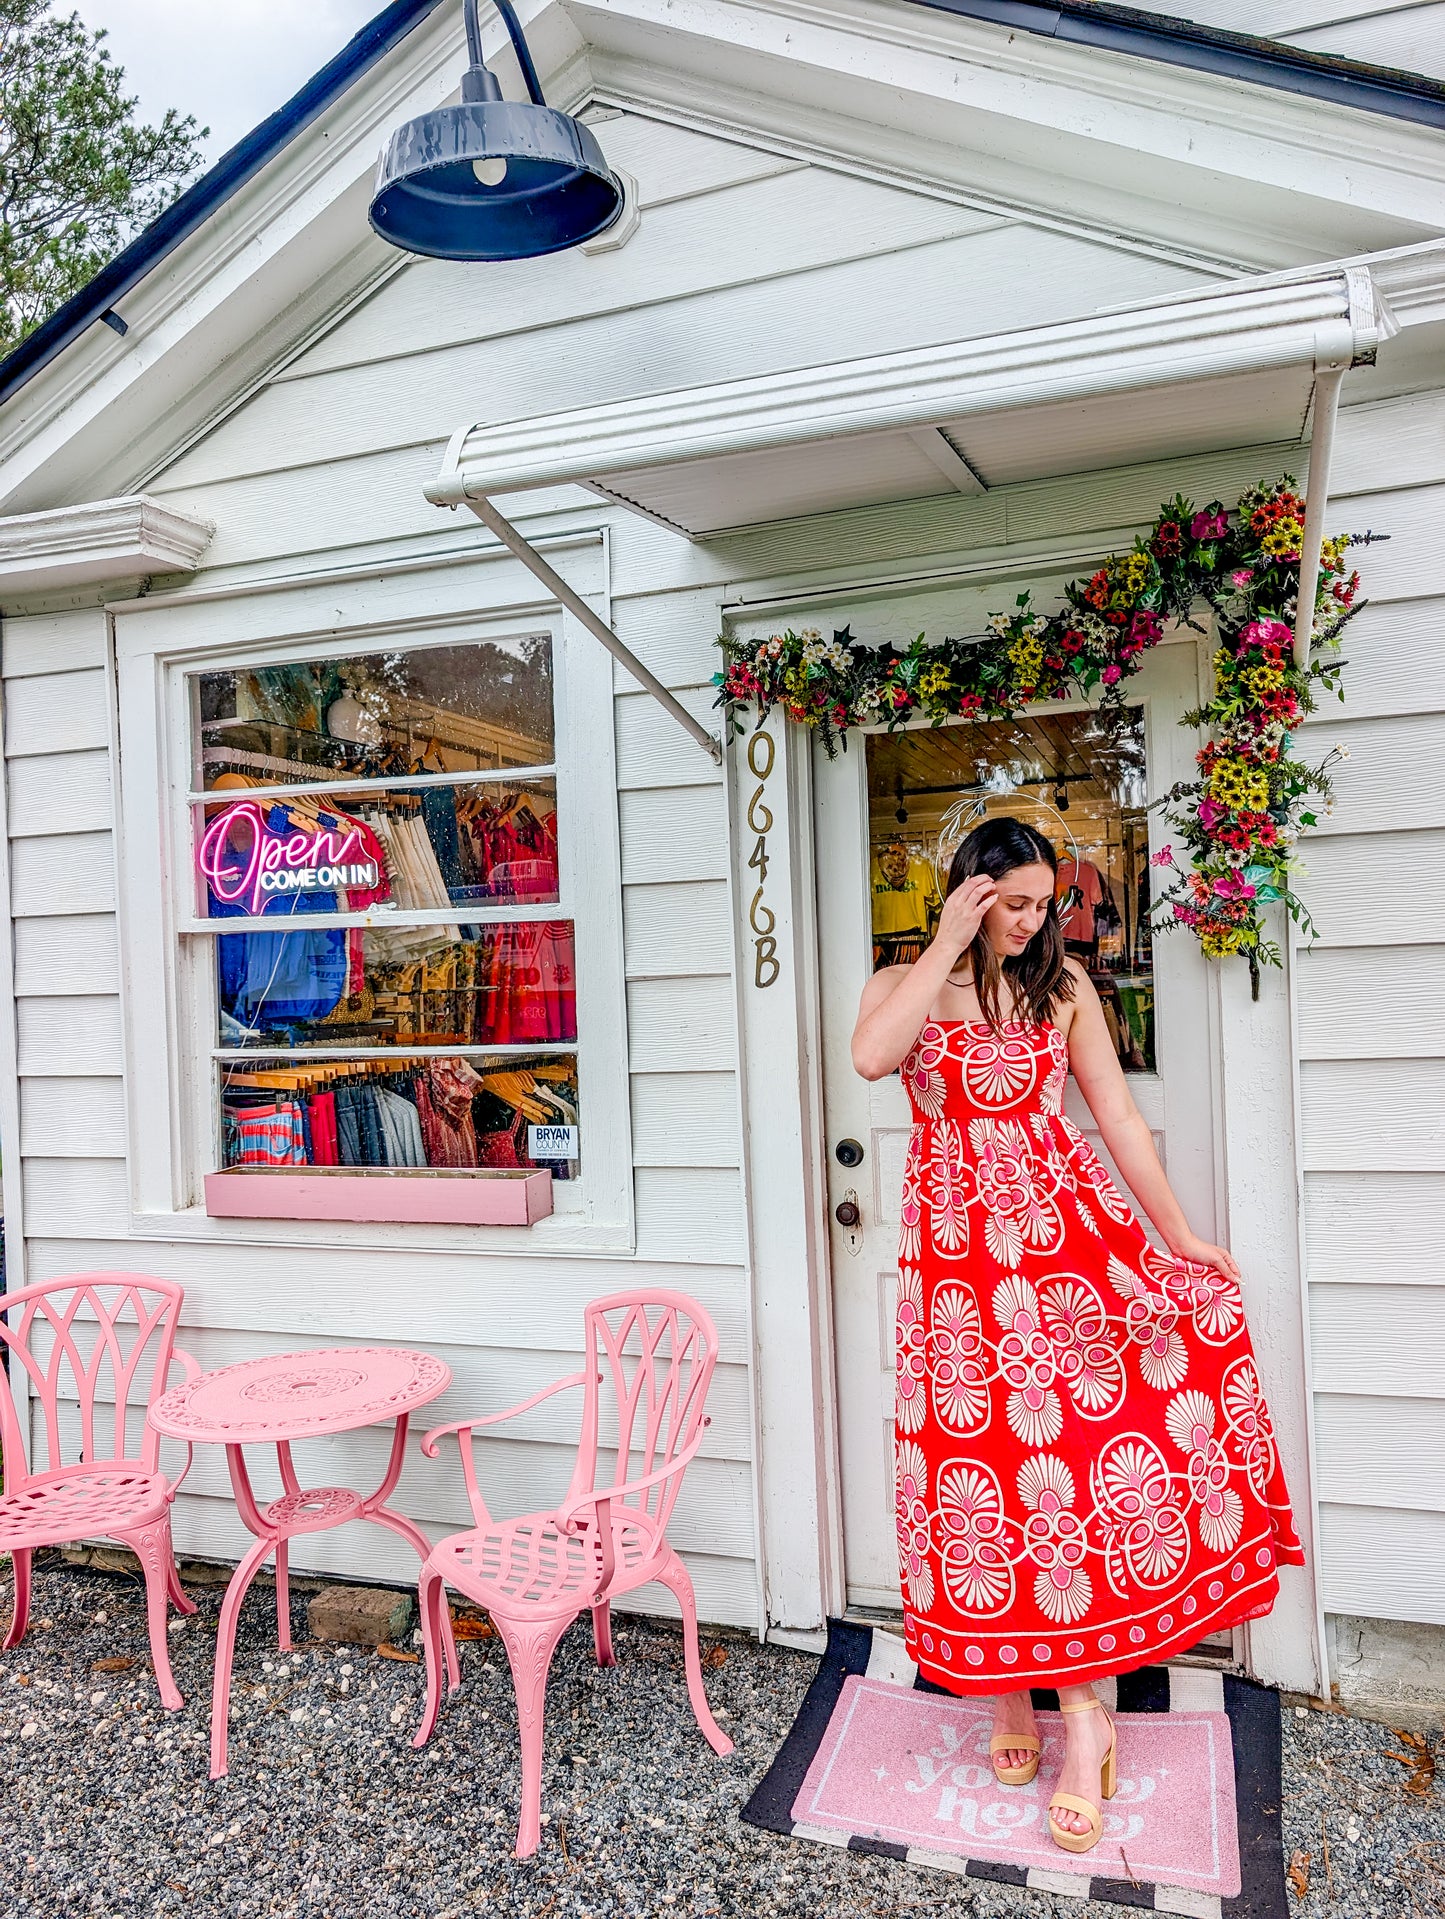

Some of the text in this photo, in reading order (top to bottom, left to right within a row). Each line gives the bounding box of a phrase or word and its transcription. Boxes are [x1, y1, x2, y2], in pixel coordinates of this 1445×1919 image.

[200, 803, 359, 913] Open
[746, 692, 780, 989] 0646B
[261, 863, 373, 890] COME ON IN
[536, 1128, 570, 1140] BRYAN
[536, 1140, 570, 1149] COUNTY
[933, 1785, 1145, 1841] hee
